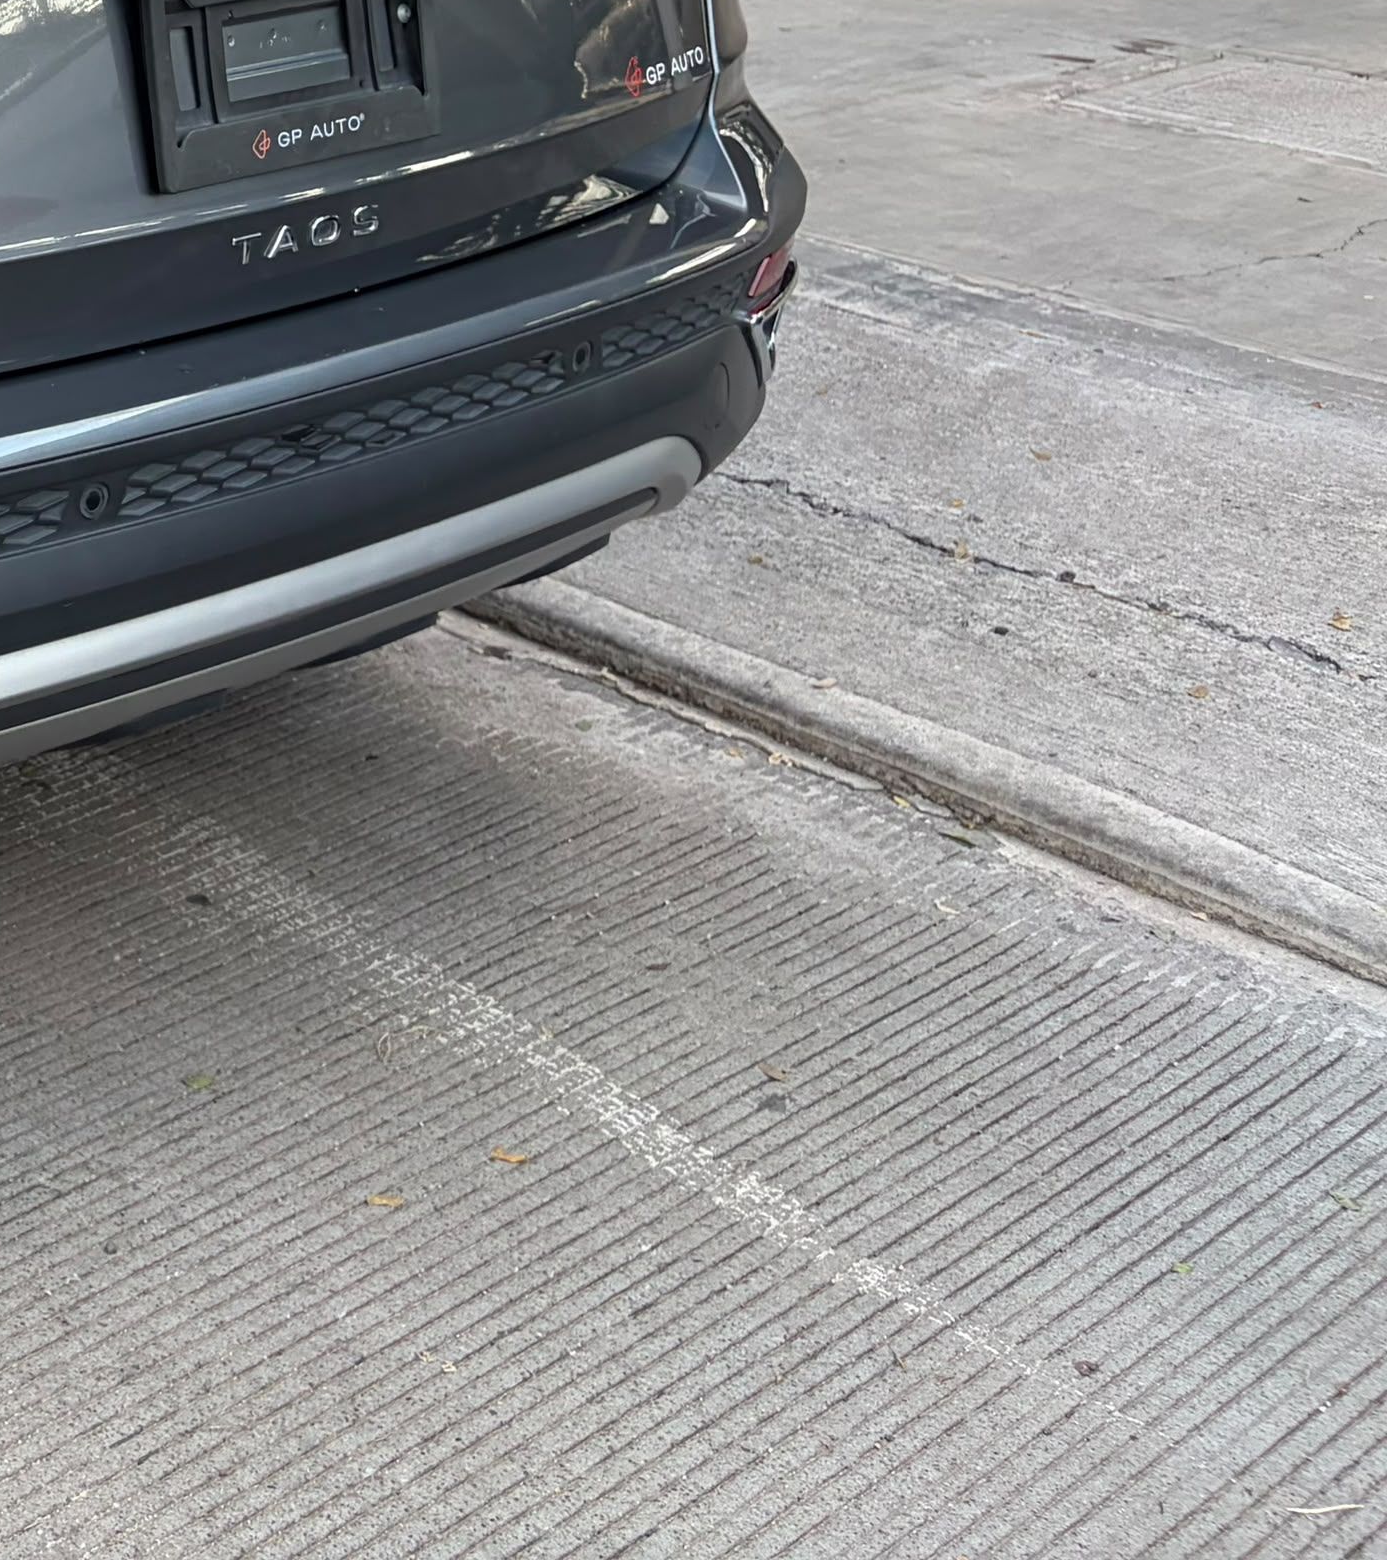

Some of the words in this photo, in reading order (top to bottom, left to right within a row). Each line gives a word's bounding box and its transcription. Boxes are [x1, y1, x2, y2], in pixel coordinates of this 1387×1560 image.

[645, 62, 666, 85] GP
[671, 46, 704, 76] AUTO
[277, 128, 303, 148] GP
[231, 204, 379, 265] TAOS
